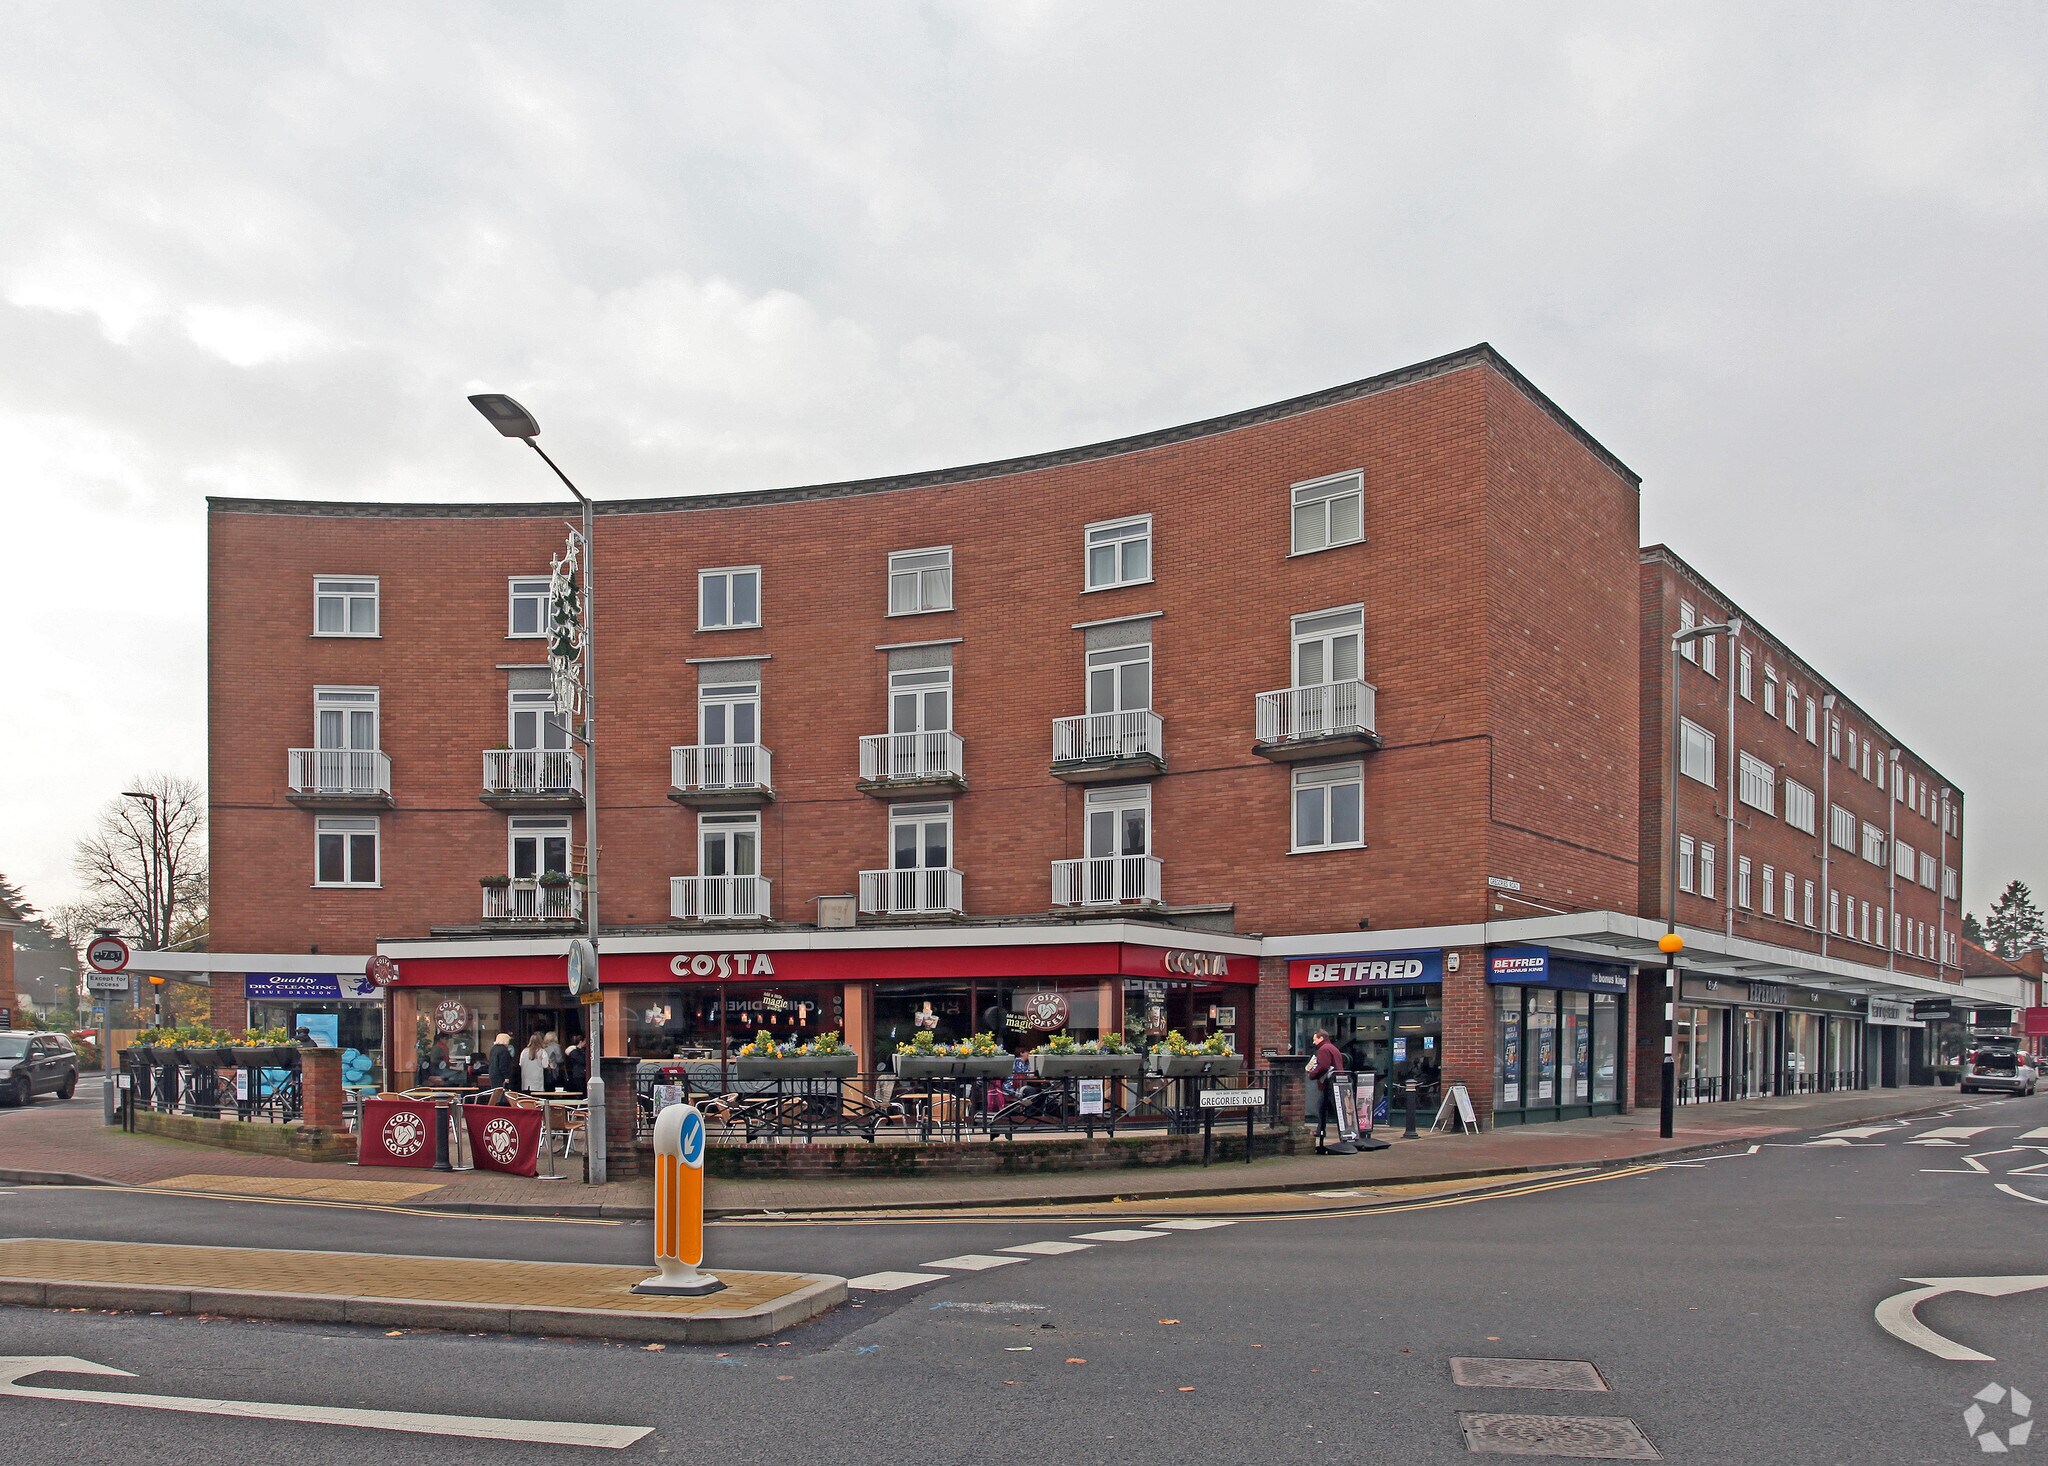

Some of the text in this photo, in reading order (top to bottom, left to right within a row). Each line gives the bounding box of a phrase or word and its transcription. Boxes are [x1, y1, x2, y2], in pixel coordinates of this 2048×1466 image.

[670, 953, 775, 978] COSTA
[1165, 950, 1229, 976] COSTA
[1493, 958, 1544, 968] BETFRED
[1308, 959, 1423, 982] BETFRED
[269, 976, 317, 984] Quality
[1598, 973, 1614, 984] bonus
[1615, 974, 1626, 987] king
[762, 996, 788, 1008] magic
[1032, 993, 1060, 1005] COSTA
[439, 1002, 461, 1011] COSTA
[438, 1020, 464, 1031] COFFEE
[1006, 1018, 1032, 1030] magic
[1030, 1014, 1064, 1028] COFFEE
[1201, 1096, 1262, 1106] GREGORIES ROAD
[390, 1114, 420, 1126] COSTA
[487, 1120, 513, 1134] COSTA
[386, 1138, 422, 1155] COFFEE
[487, 1144, 516, 1163] COFFEE
